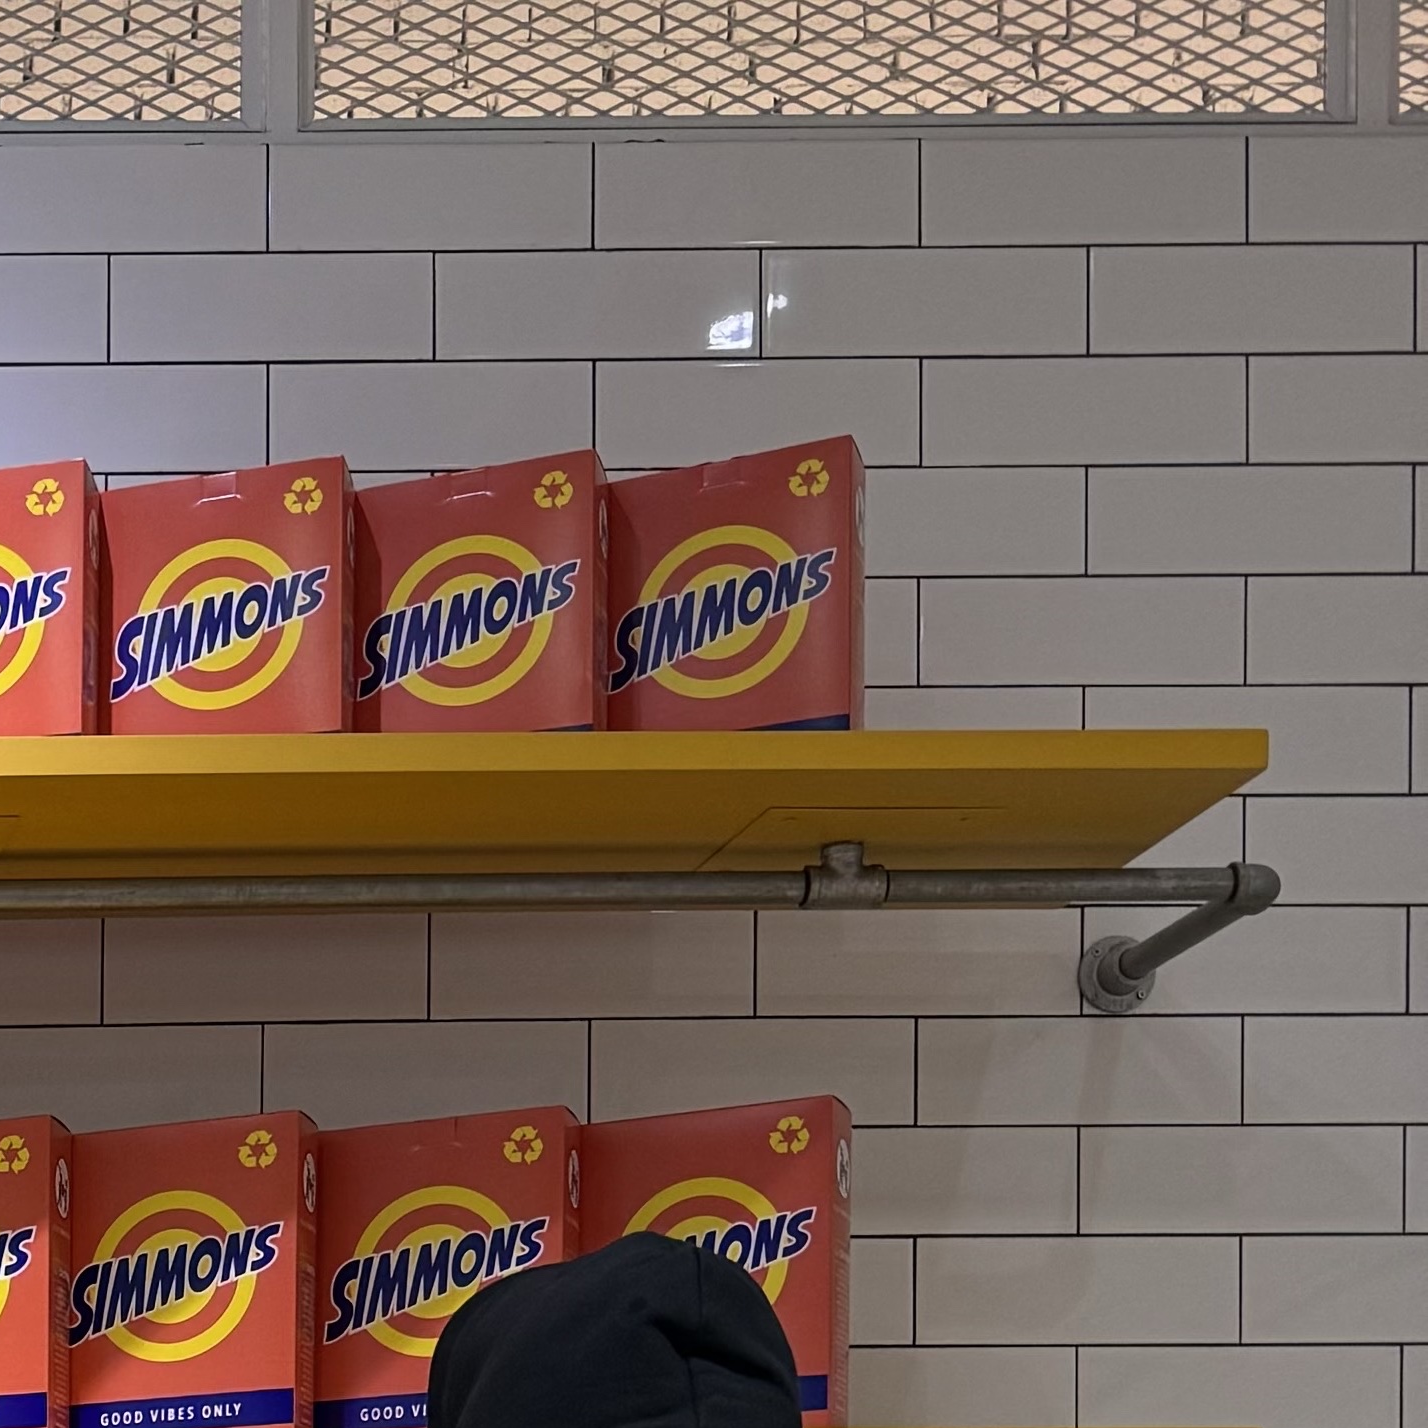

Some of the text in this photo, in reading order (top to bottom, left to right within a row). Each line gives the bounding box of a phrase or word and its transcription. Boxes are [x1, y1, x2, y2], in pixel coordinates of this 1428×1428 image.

[109, 566, 330, 703] SIMMONS
[358, 560, 580, 698] SIMMONS
[609, 549, 836, 692] SIMMONS
[67, 1222, 283, 1346] SIMMONS
[324, 1216, 549, 1345] SIMMONS
[100, 1402, 242, 1427] GOOD VIBES ONLY
[359, 1405, 405, 1422] GOOD
